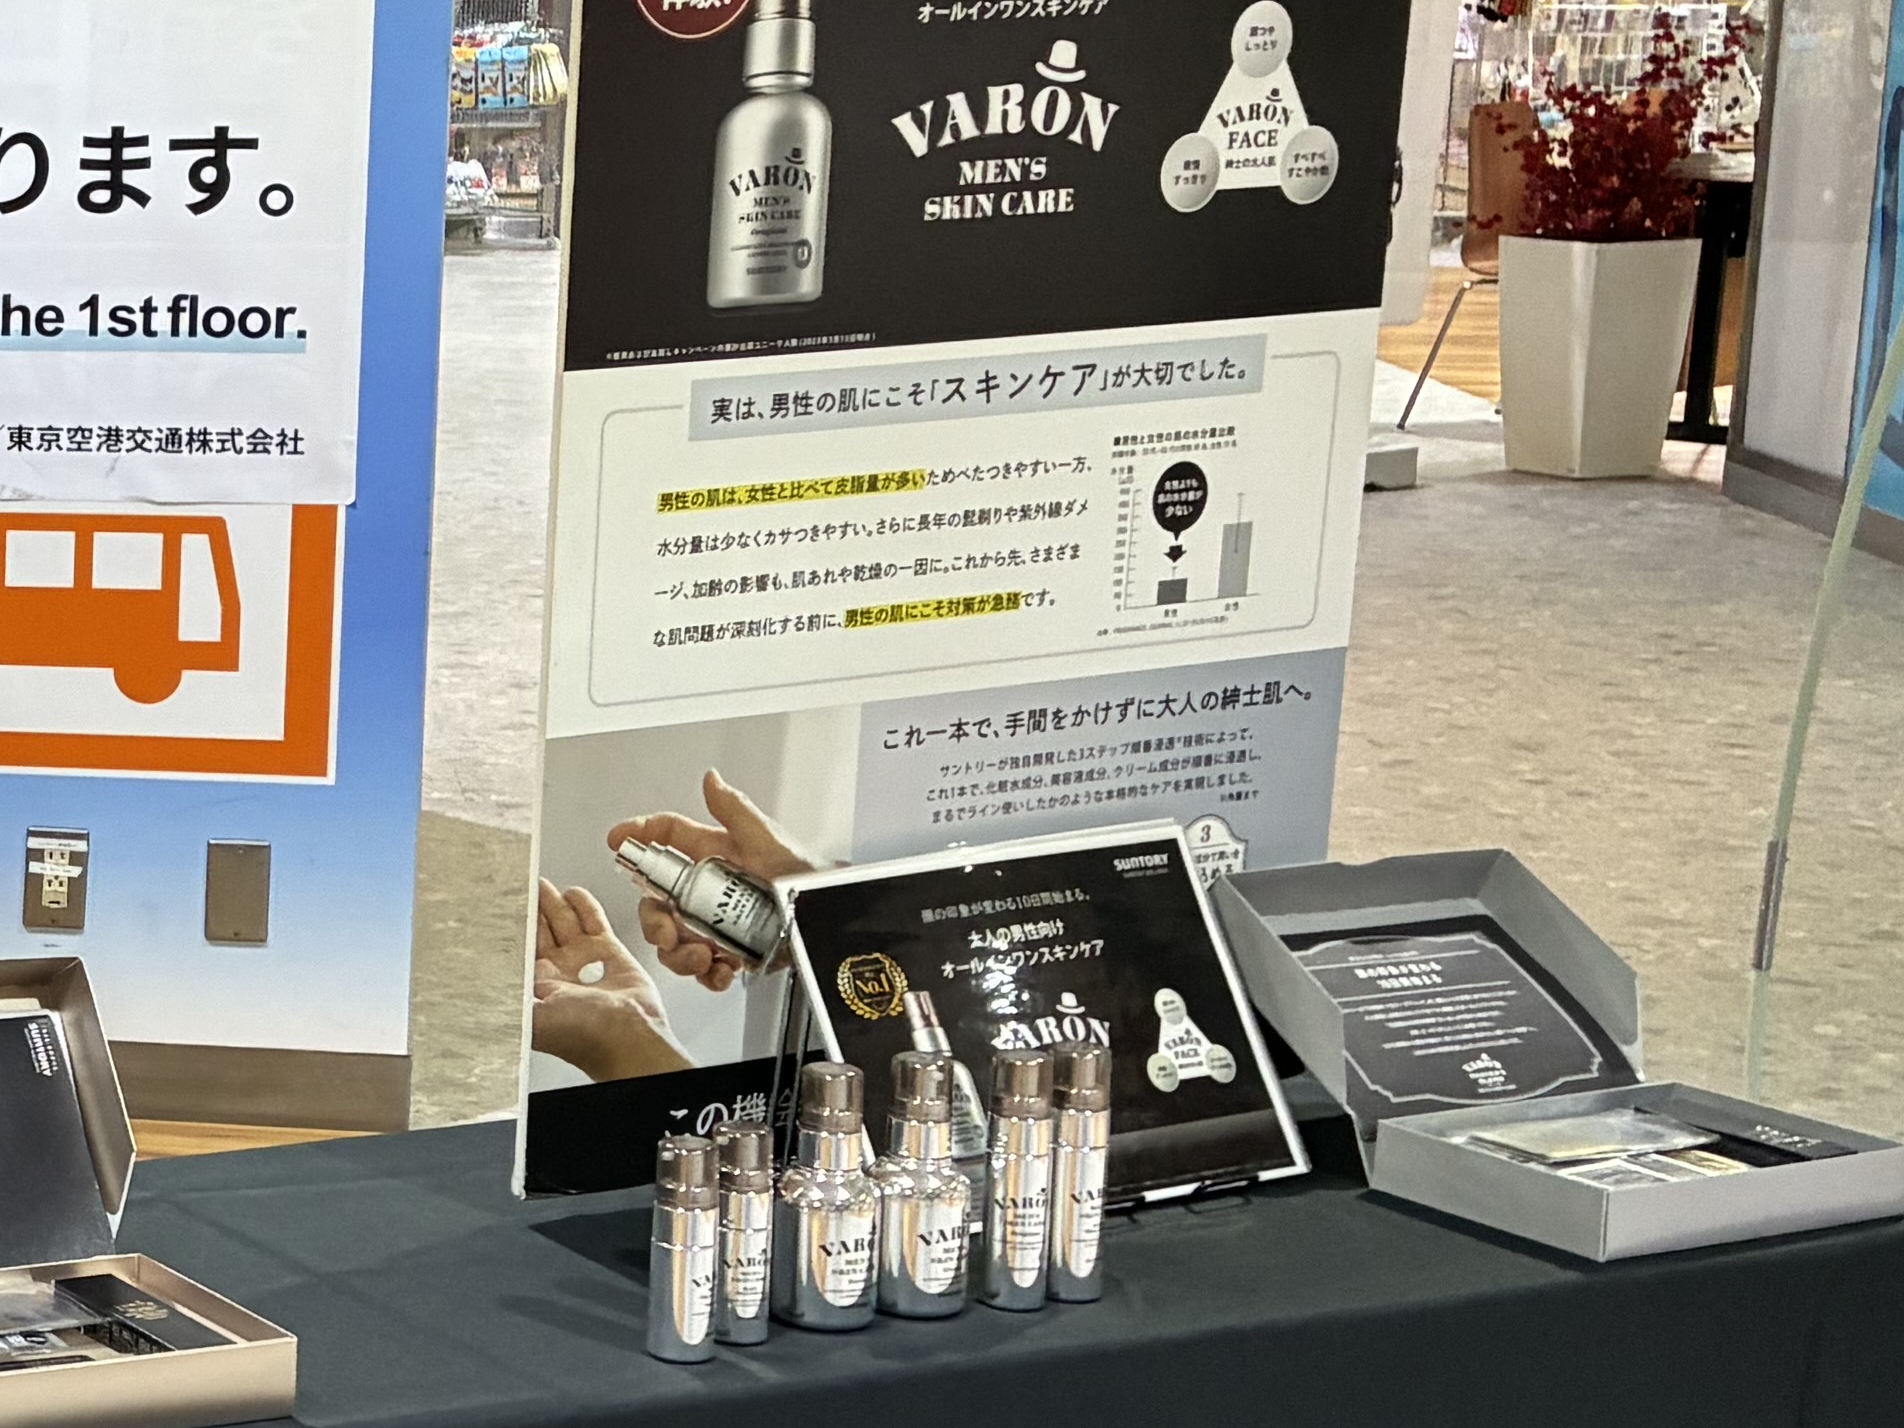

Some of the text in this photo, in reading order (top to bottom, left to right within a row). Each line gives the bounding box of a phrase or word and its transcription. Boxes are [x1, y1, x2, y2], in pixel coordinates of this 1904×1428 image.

[891, 80, 1121, 160] VARON
[1216, 102, 1295, 129] VARON
[1227, 129, 1279, 149] FACE
[728, 164, 816, 198] VARON
[958, 155, 1048, 187] MEN'S
[923, 186, 1075, 222] SKIN CARE
[78, 295, 158, 338] 1st
[170, 294, 307, 340] floor.
[710, 358, 1248, 425] 実は、男性の肌にこそ「スキンケア」が大切でした。
[883, 681, 1313, 750] これ一本で、手間をかけずに大人の紳士肌へ。
